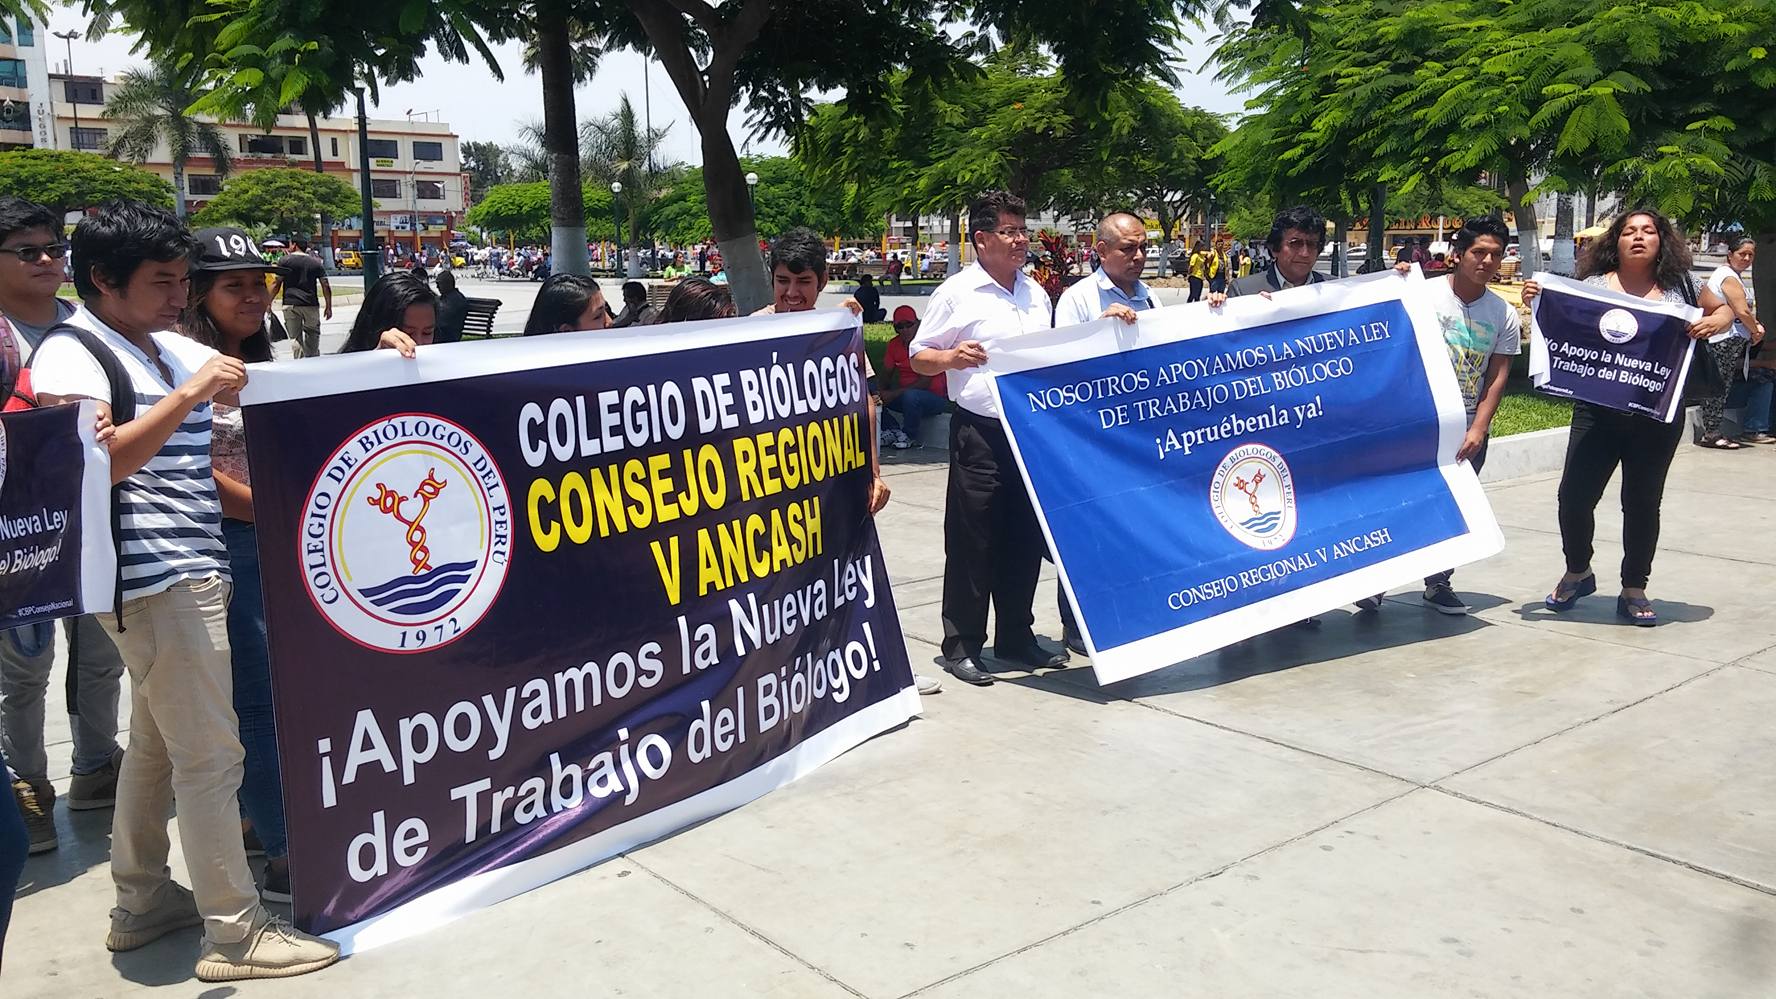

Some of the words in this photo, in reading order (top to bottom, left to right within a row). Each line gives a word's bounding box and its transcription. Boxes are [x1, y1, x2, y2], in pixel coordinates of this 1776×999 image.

[1418, 212, 1464, 230] ROUG
[1027, 370, 1150, 412] NOSOTROS
[1155, 346, 1268, 387] APOYAMOS
[1271, 341, 1297, 362] LA
[1295, 328, 1361, 357] NUEVA
[1363, 320, 1391, 343] LEY
[1098, 405, 1130, 430] DE
[1133, 382, 1229, 422] TRABAJO
[1233, 376, 1271, 399] DEL
[1275, 356, 1354, 390] BIÓLOGO
[1552, 356, 1595, 378] Trabajo
[1598, 367, 1617, 381] del
[1618, 370, 1666, 393] Biólogo!
[1559, 342, 1598, 361] Apoyo
[1601, 350, 1611, 363] la
[1614, 353, 1651, 372] Nueva
[1653, 362, 1672, 380] Ley
[519, 380, 686, 467] COLEGIO
[692, 373, 739, 434] DE
[739, 352, 861, 429] BIÓLOGOS
[1156, 404, 1290, 460] ¡Apruébenla
[1295, 395, 1324, 430] ya!
[527, 443, 727, 552] CONSEJO
[732, 412, 866, 502] REGIONAL
[1218, 462, 1230, 478] DE
[1277, 461, 1288, 482] DEL
[0, 514, 42, 541] Nueva
[43, 507, 68, 534] Ley
[307, 491, 339, 605] COLEGIO
[326, 451, 358, 485] DE
[357, 419, 473, 456] BIÓLOGOS
[472, 454, 500, 498] DEL
[492, 503, 508, 566] PERÚ
[10, 538, 62, 574] Biólogo!
[650, 536, 681, 606] V
[699, 496, 824, 597] ANCASH
[1167, 577, 1239, 611] CONSEJO
[1239, 552, 1318, 589] REGIONAL
[1315, 549, 1327, 563] V
[1333, 527, 1393, 560] ANCASH
[398, 617, 461, 648] 1972
[317, 641, 663, 808] ¡Apoyamos
[677, 615, 719, 675] la
[728, 578, 828, 657] Nueva
[834, 554, 873, 608] Ley
[347, 811, 428, 883] de
[450, 727, 673, 844] Trabajo
[686, 686, 746, 764] del
[757, 621, 881, 735] Biólogo!
